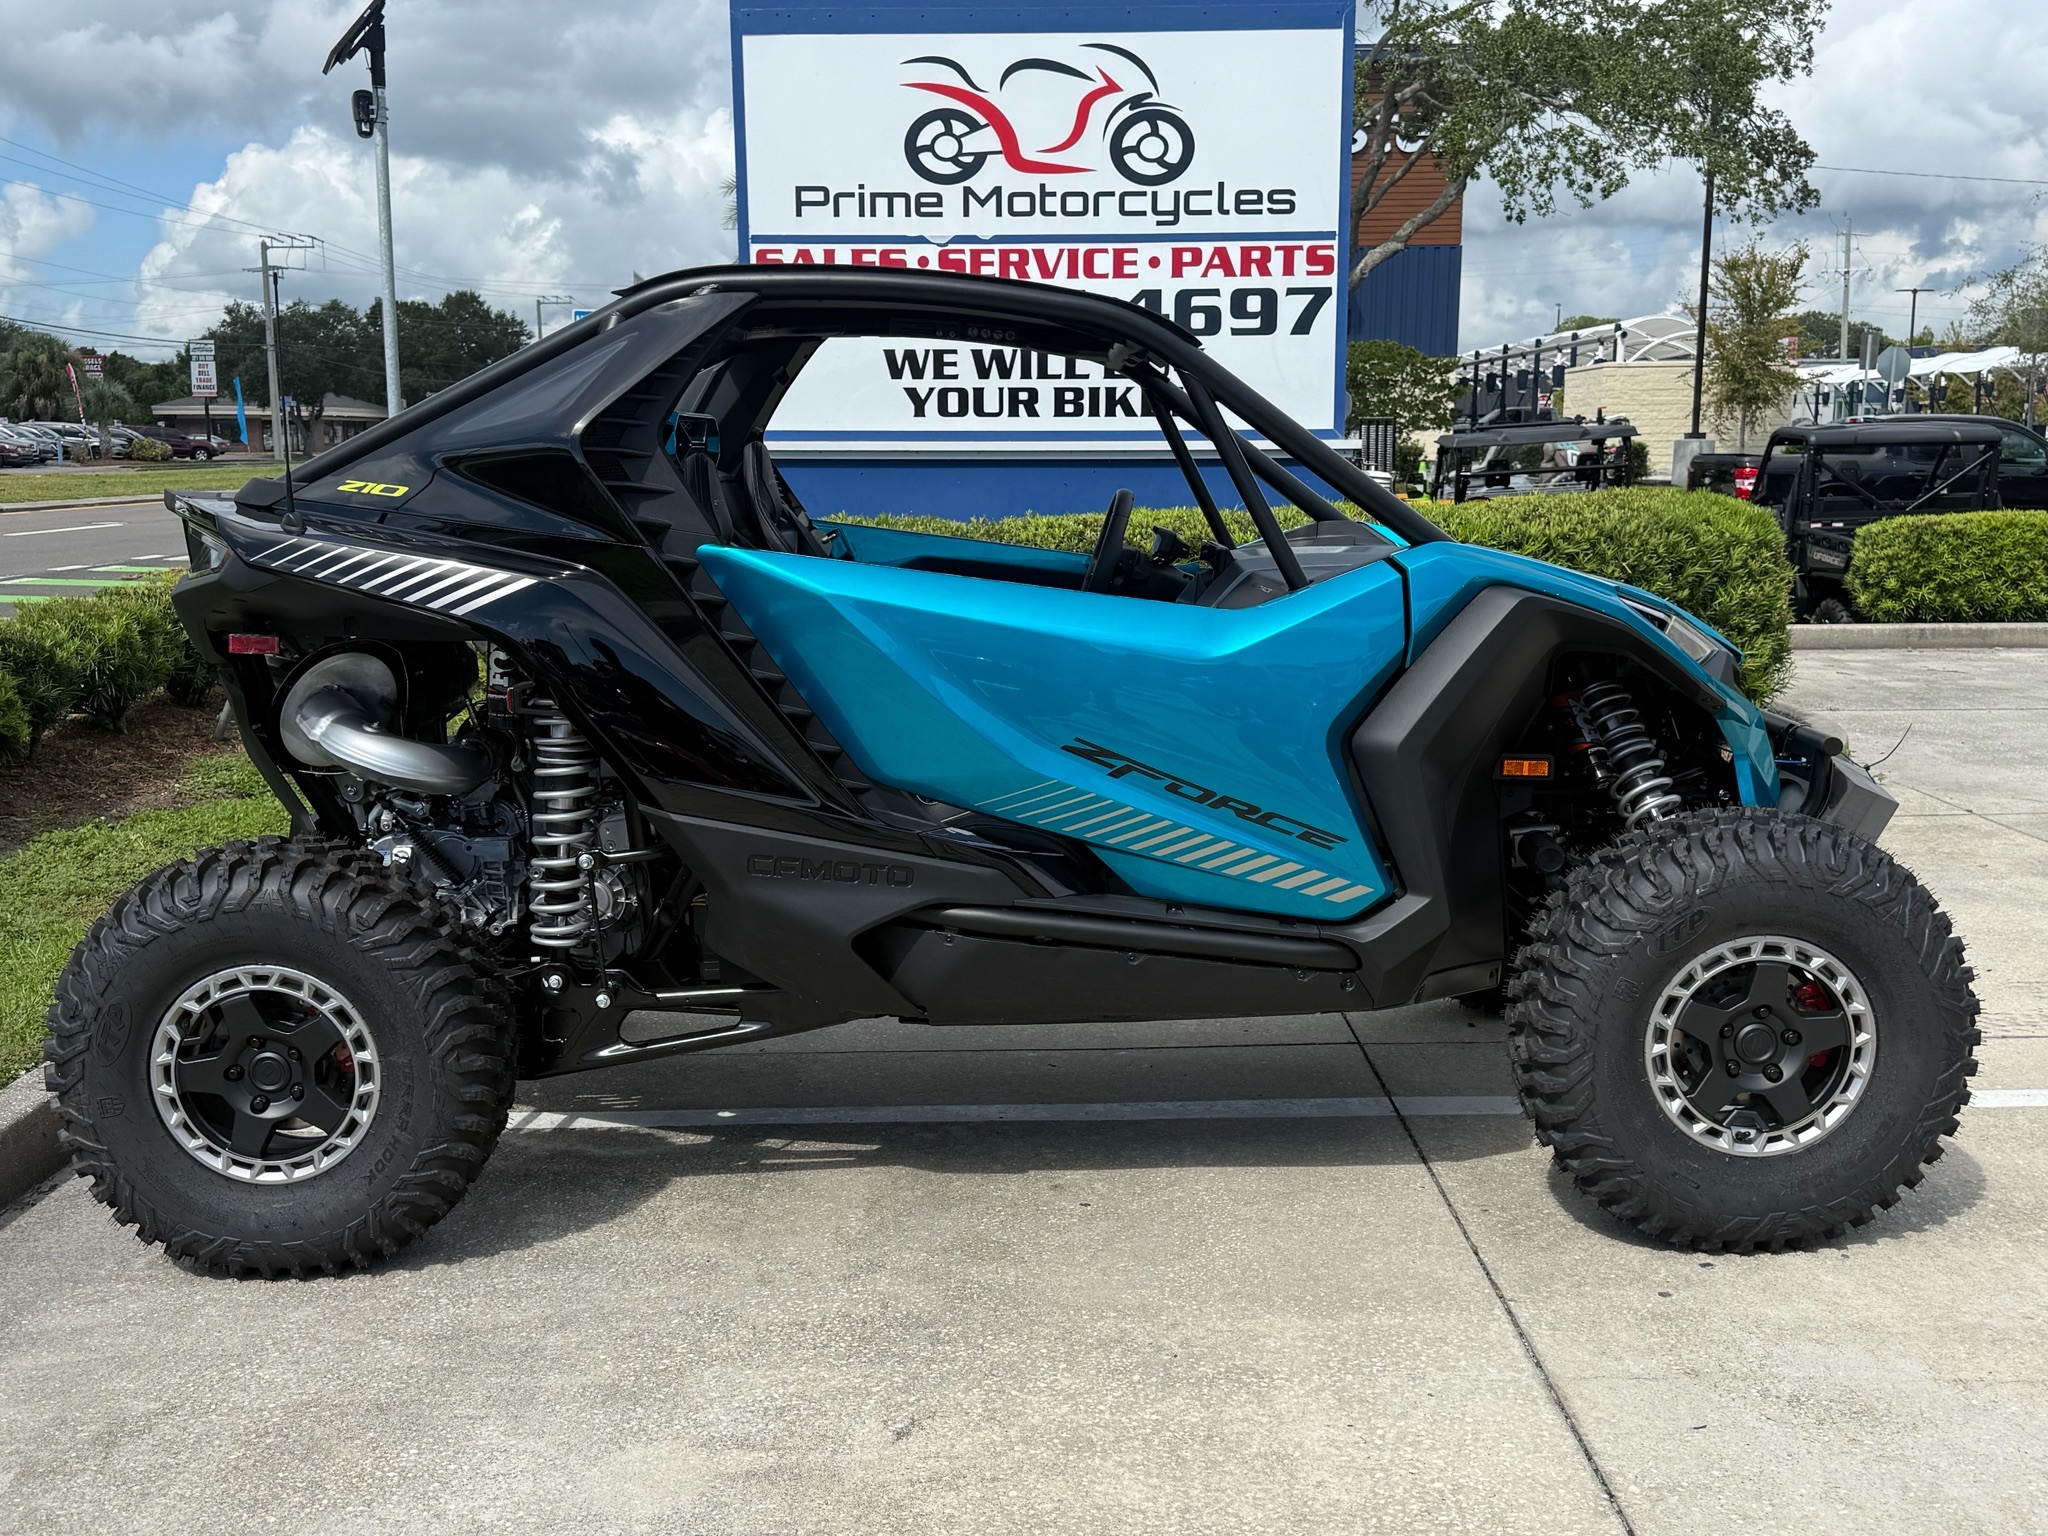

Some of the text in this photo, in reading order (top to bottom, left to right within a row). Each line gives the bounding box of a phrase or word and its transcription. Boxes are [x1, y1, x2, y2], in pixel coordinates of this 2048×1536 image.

[795, 182, 1297, 227] Prime Motorcycles
[938, 247, 1139, 279] SERVICE
[1171, 245, 1335, 279] PARTS
[883, 349, 960, 380] WE
[970, 349, 1091, 380] WILL
[902, 387, 1041, 418] YOUR
[336, 480, 410, 497] Z10
[746, 854, 915, 889] CFMOTO
[1657, 909, 1706, 953] ITP
